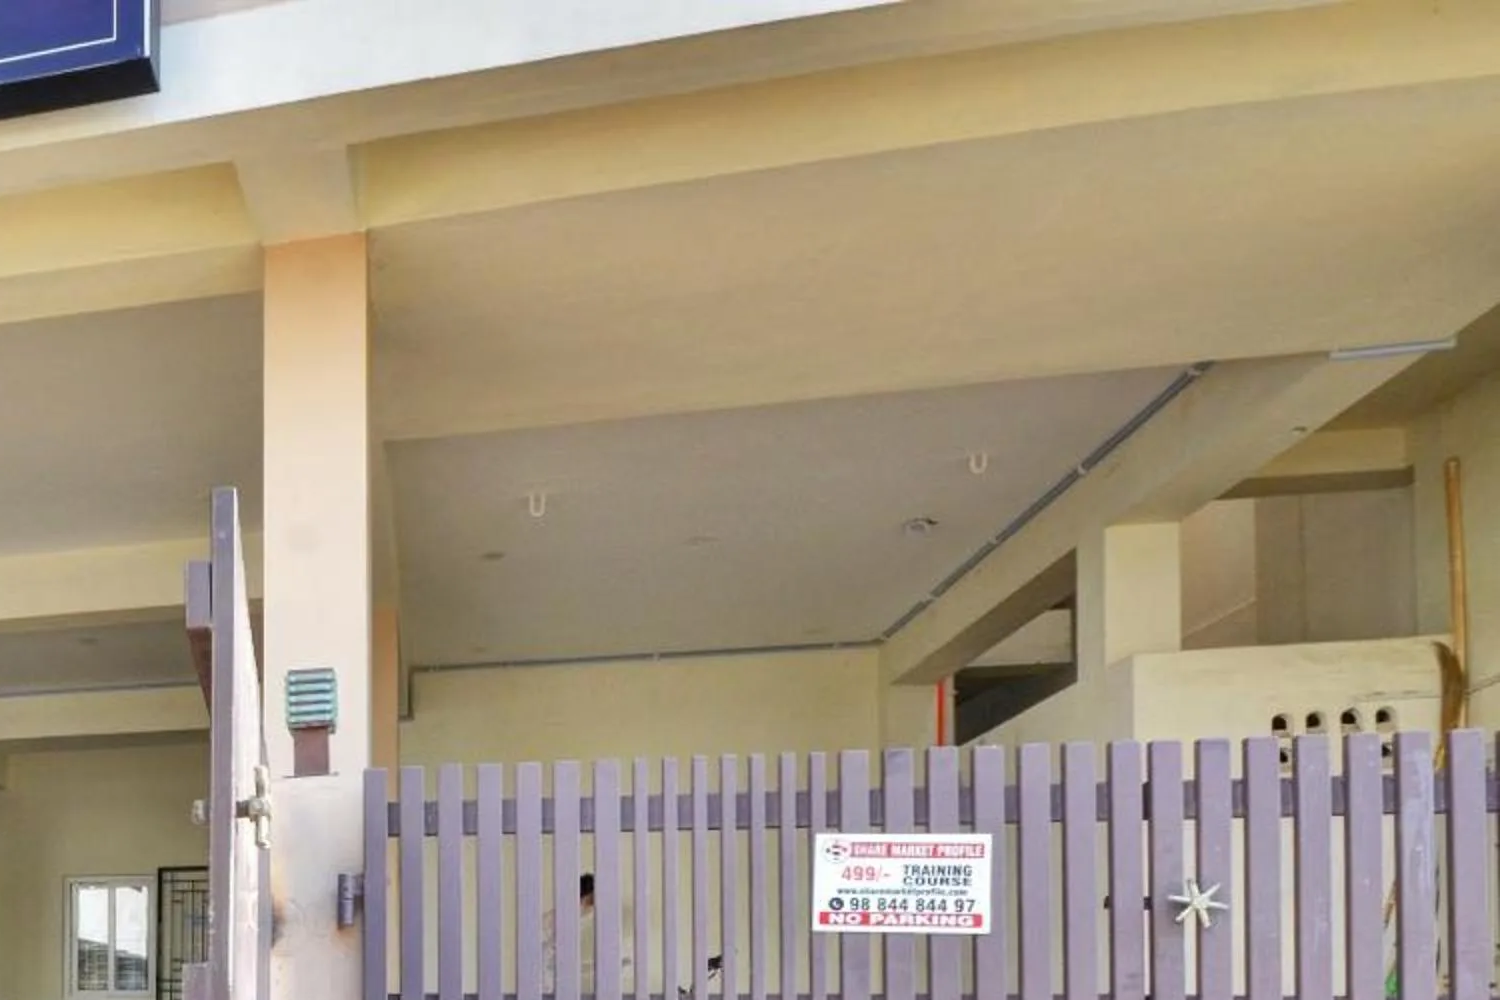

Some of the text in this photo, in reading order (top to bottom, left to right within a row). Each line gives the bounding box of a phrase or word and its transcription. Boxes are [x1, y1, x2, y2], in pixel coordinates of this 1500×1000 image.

[853, 843, 985, 858] SHARE MARKET PROFILE
[841, 865, 891, 882] 499/-
[903, 864, 973, 877] TRAINING
[903, 876, 973, 886] COURSE
[850, 898, 976, 912] 98 844 844 97
[829, 912, 974, 927] NO PARKING
